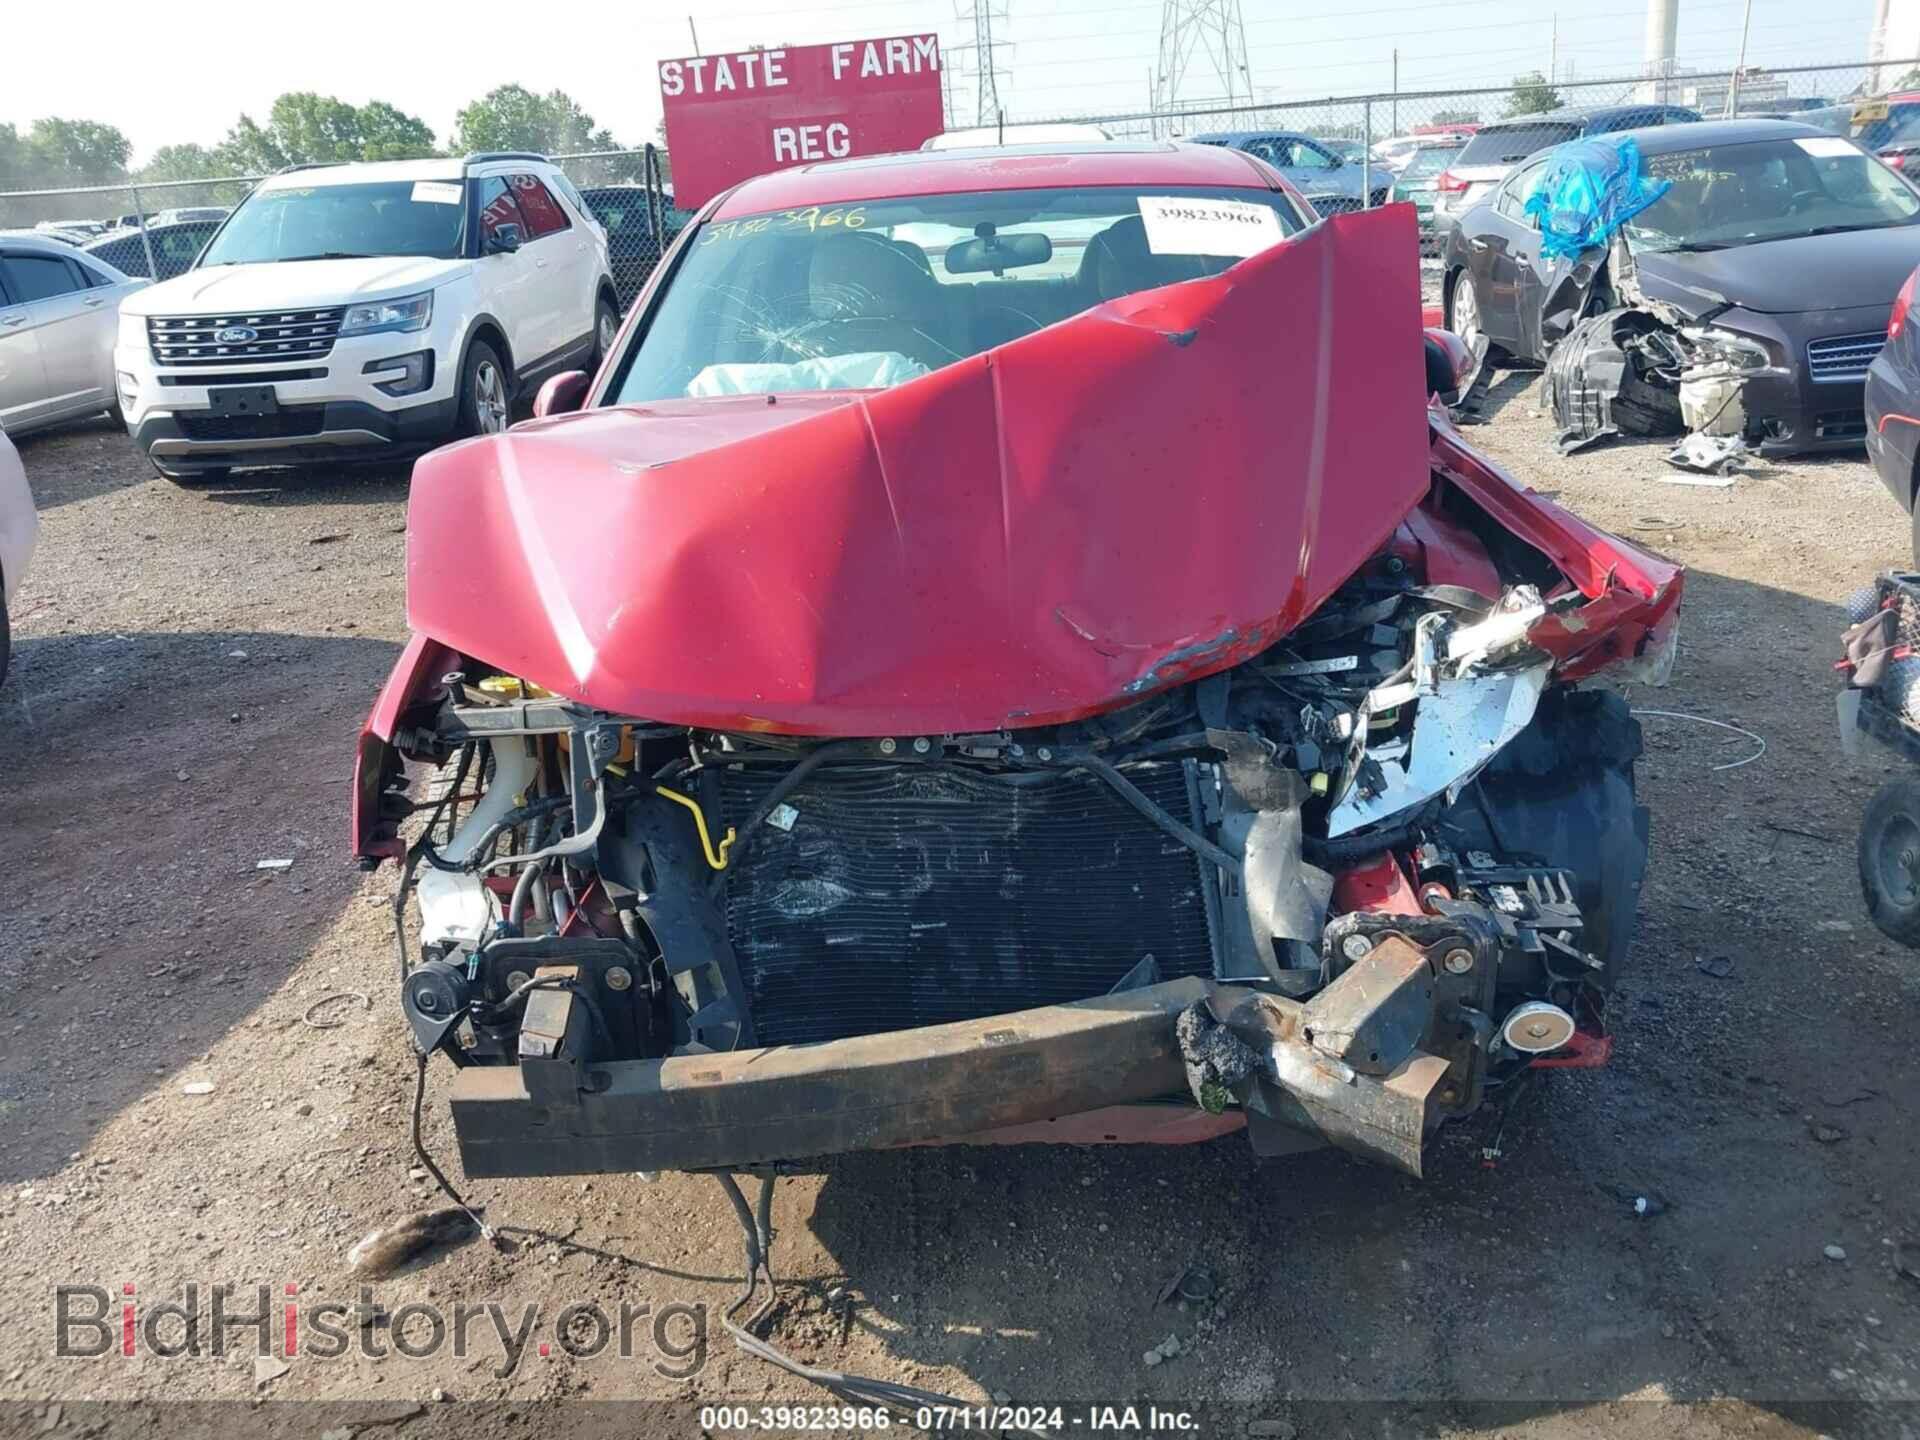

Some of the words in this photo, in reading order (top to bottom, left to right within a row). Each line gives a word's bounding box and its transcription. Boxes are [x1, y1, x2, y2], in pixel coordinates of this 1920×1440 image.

[660, 52, 788, 95] STATE
[832, 36, 938, 80] FARM
[773, 122, 850, 162] REG
[1157, 207, 1262, 225] 39823966
